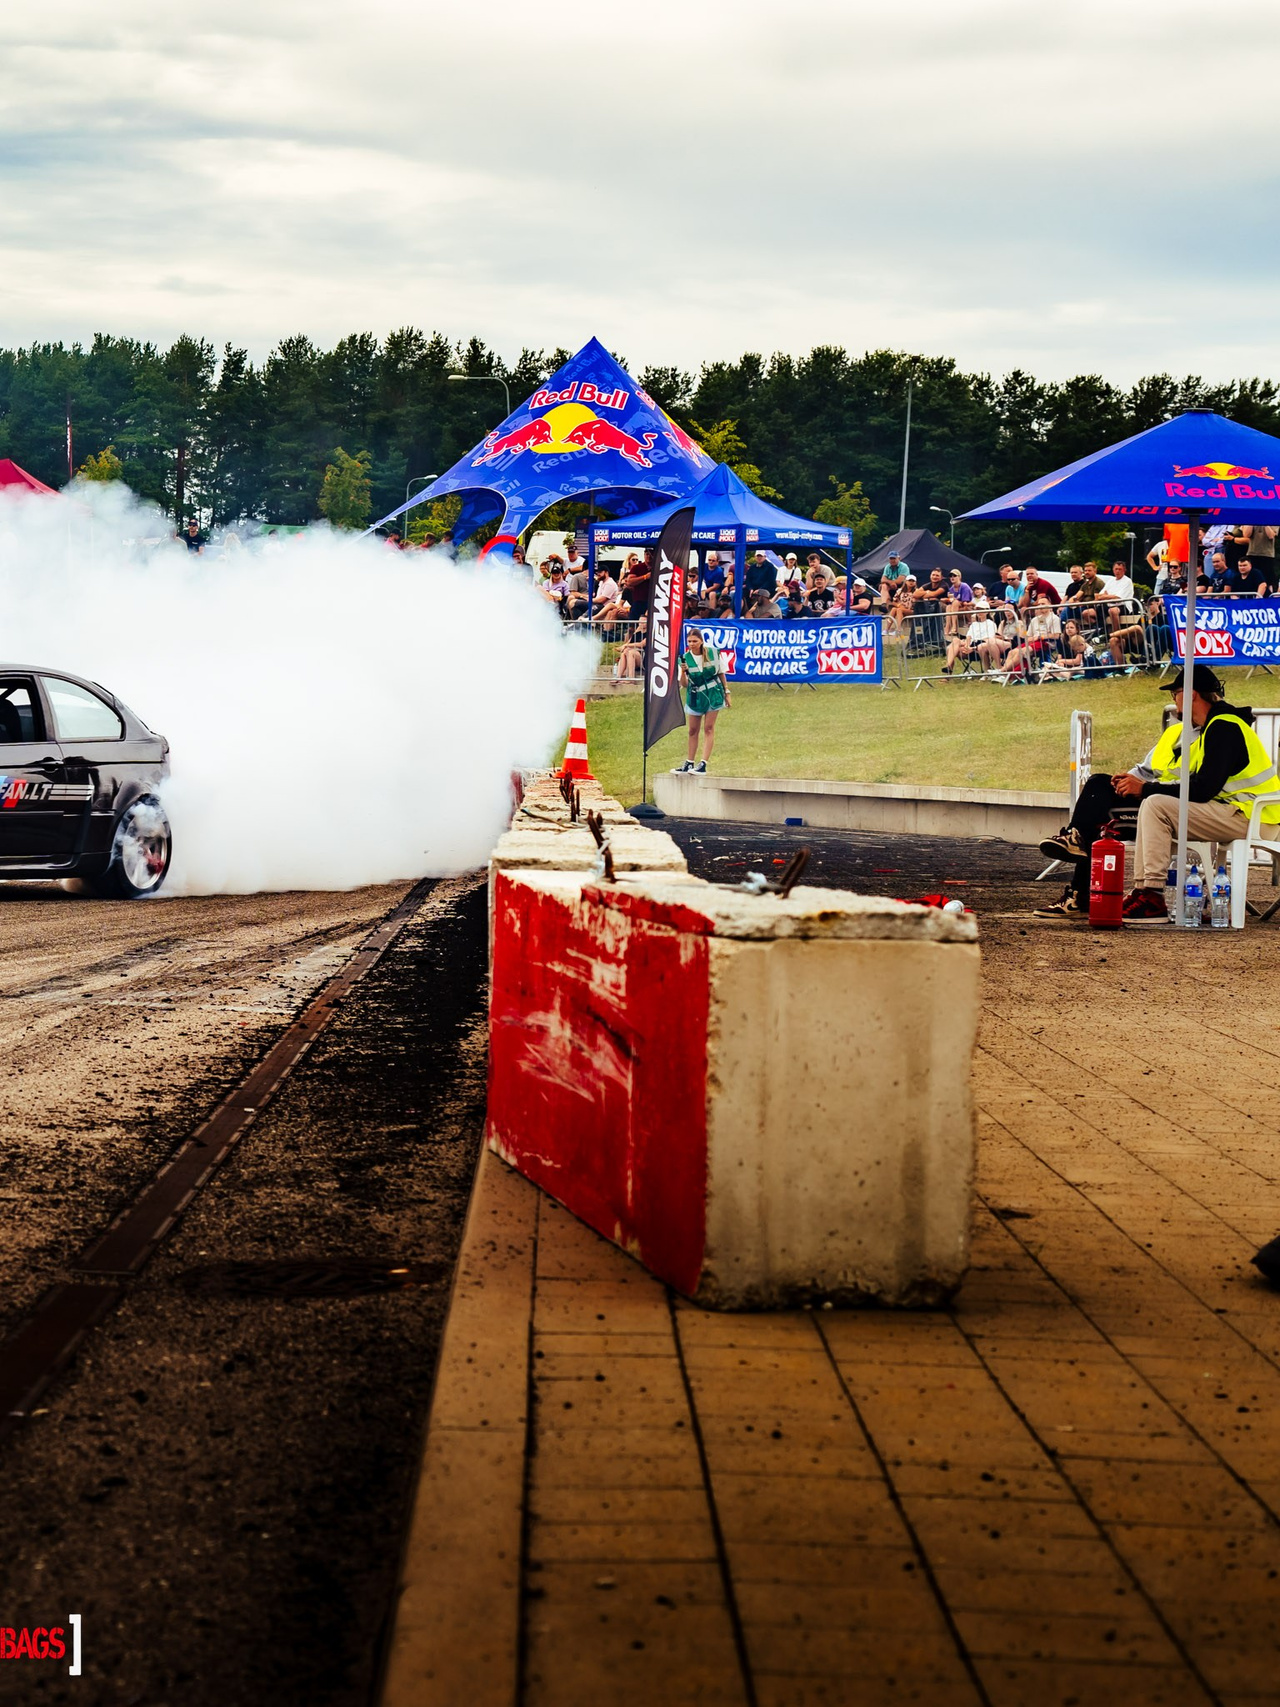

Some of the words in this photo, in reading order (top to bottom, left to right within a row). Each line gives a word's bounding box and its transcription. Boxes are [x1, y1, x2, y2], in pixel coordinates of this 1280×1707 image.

[529, 381, 579, 409] Red
[577, 382, 629, 410] Bull
[1164, 482, 1228, 498] Red
[672, 573, 681, 610] TEAM
[650, 549, 674, 698] ONEWAY
[1231, 608, 1278, 625] MOTOR
[742, 629, 787, 644] MOTOR
[788, 628, 817, 643] OILS
[820, 625, 873, 649] LIQUI
[744, 645, 810, 660] ADDITIVES
[820, 649, 874, 672] MOLY
[744, 661, 771, 675] CAR
[773, 661, 809, 675] CARE
